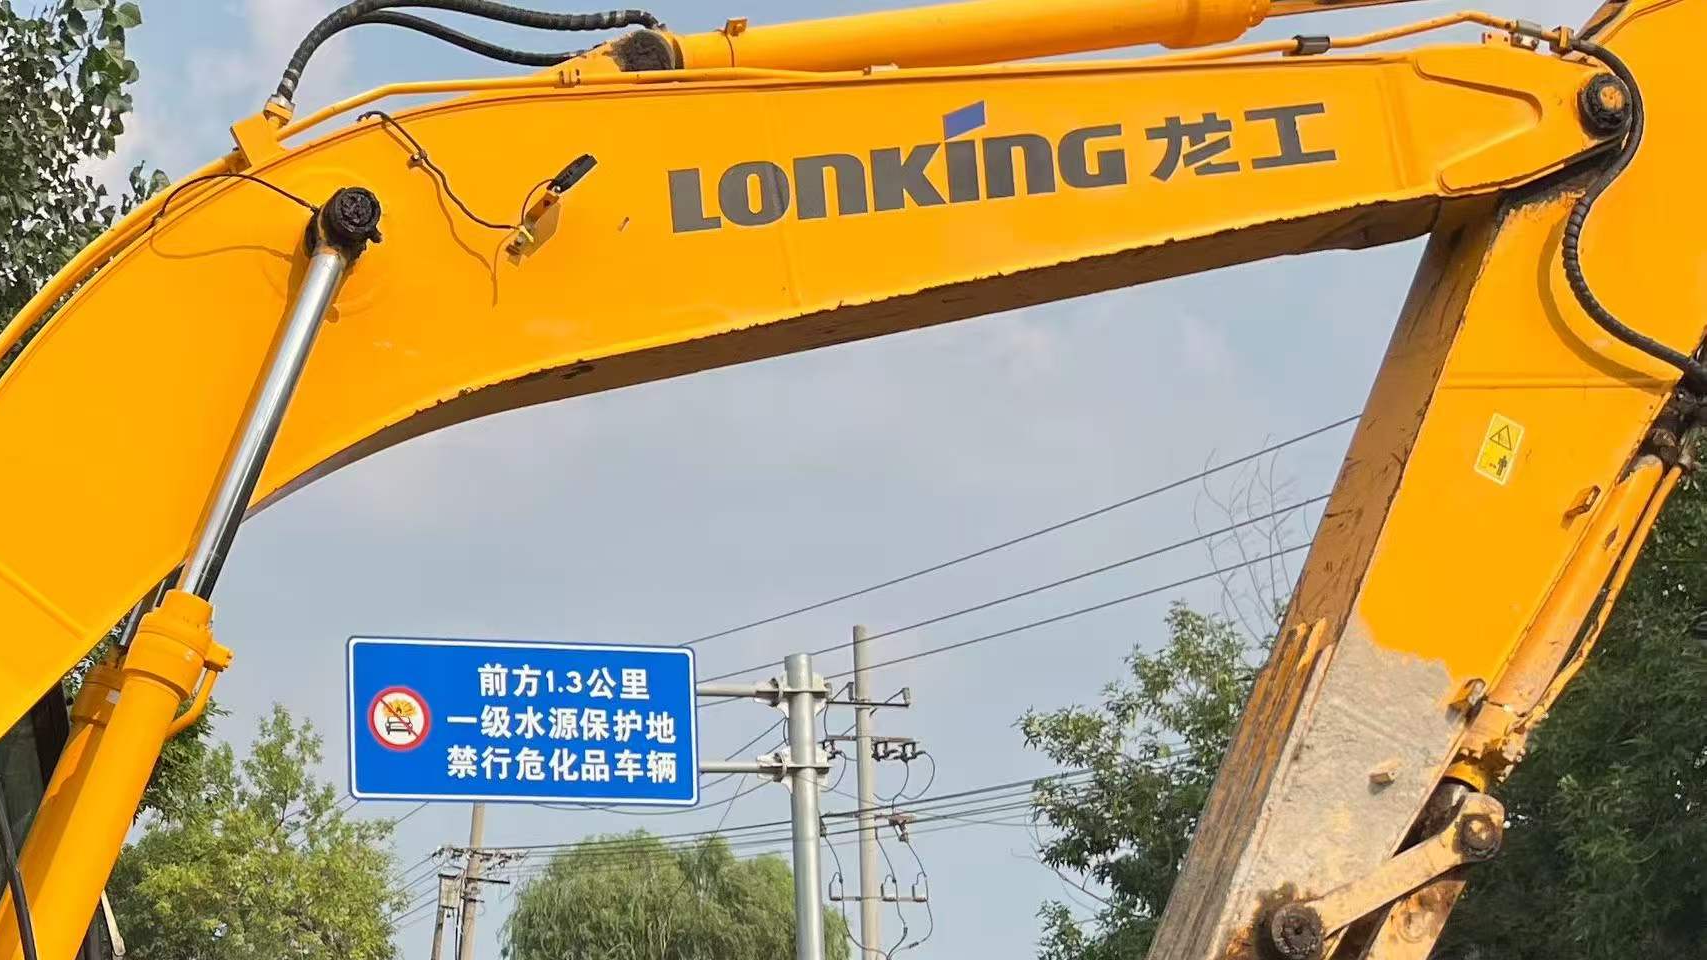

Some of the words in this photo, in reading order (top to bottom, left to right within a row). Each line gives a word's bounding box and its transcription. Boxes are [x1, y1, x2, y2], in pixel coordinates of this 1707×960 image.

[1145, 103, 1336, 181] 龙工
[477, 664, 650, 700] 前方1.3公里
[446, 705, 677, 743] 一级水源保护地
[446, 745, 677, 784] 禁行危化品车辆
